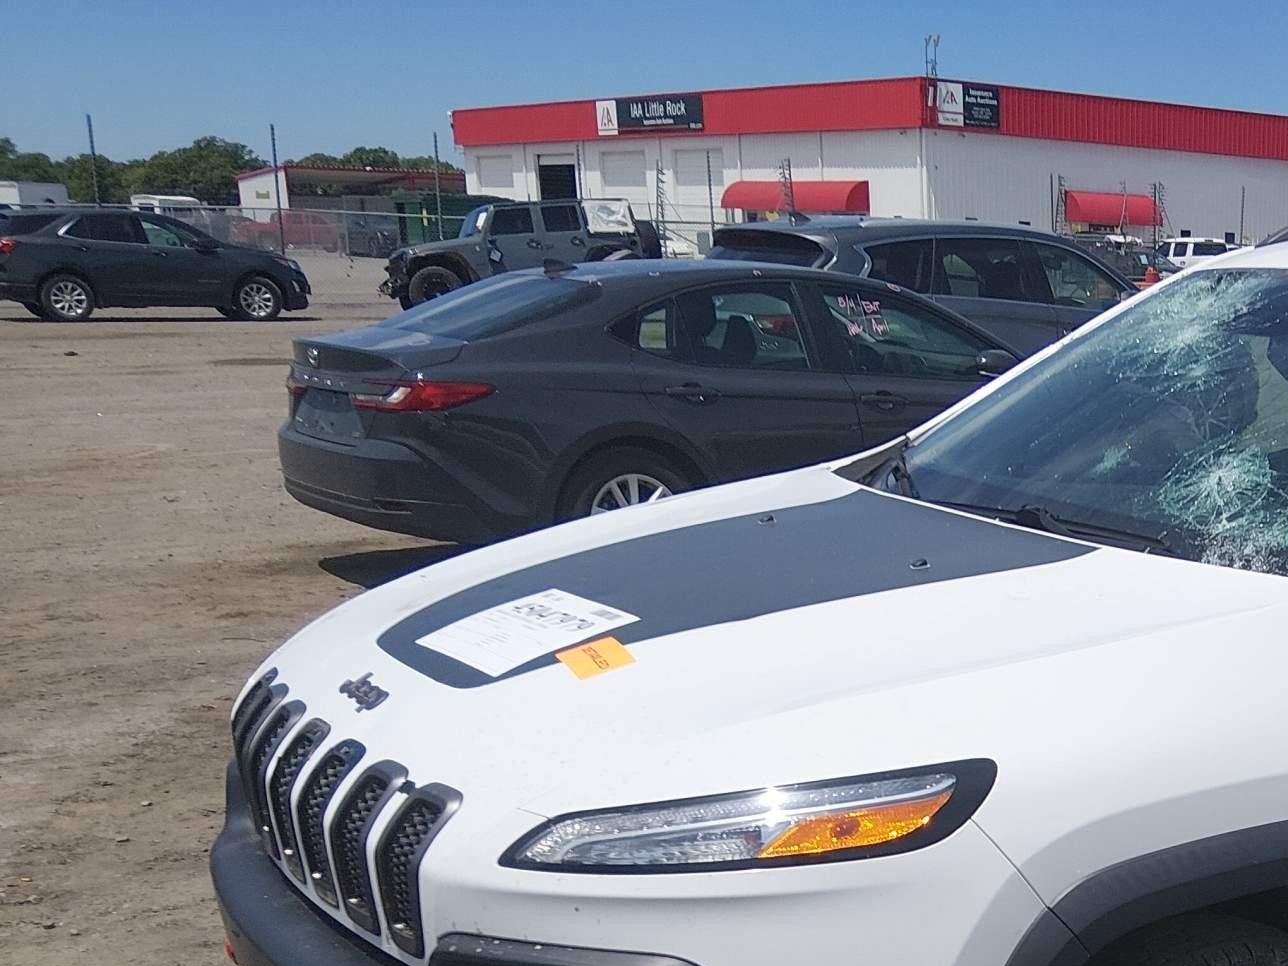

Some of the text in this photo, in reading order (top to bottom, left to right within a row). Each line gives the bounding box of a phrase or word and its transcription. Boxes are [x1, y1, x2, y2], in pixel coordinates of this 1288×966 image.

[630, 99, 687, 118] IAA Little Rock
